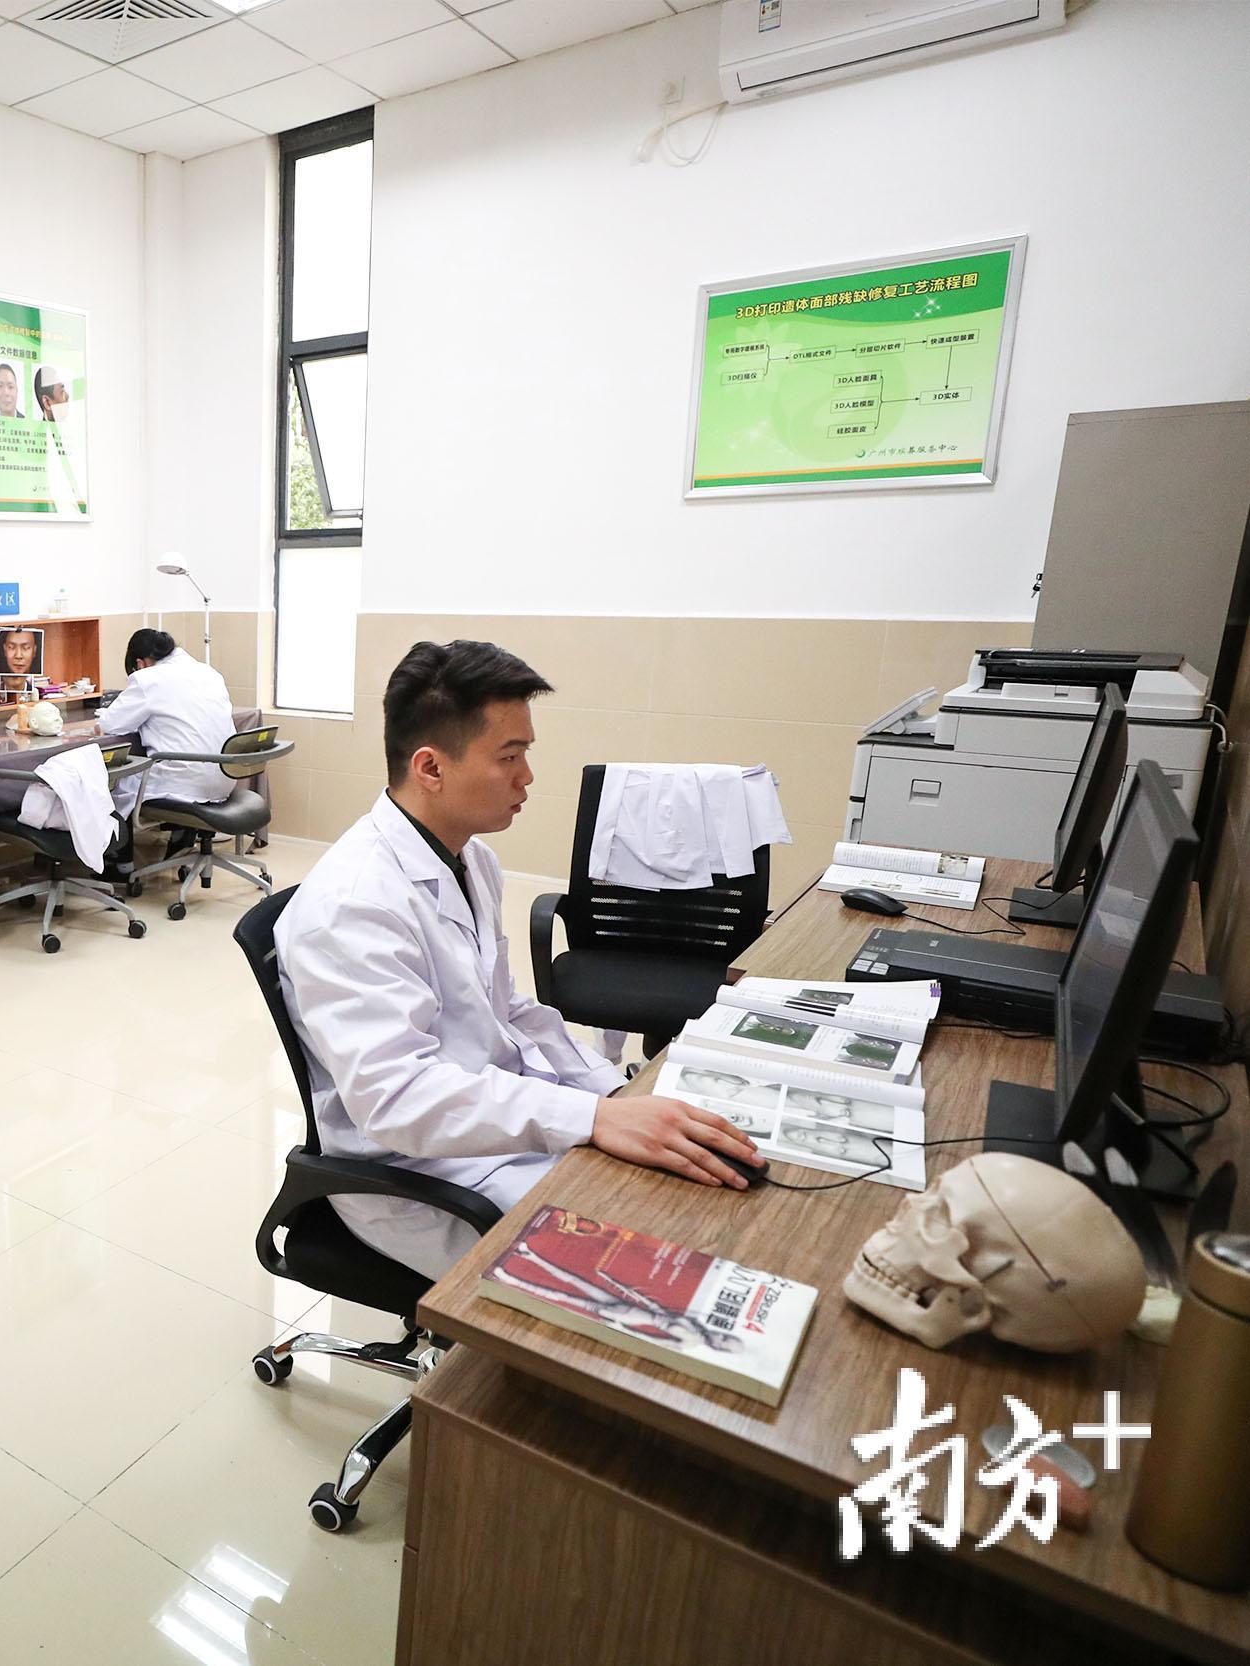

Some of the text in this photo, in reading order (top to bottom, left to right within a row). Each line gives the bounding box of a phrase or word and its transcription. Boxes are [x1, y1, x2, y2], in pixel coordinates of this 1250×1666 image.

[735, 272, 979, 319] 3D打印遗体面部残缺修复工艺流程图
[932, 392, 959, 400] 3D实体
